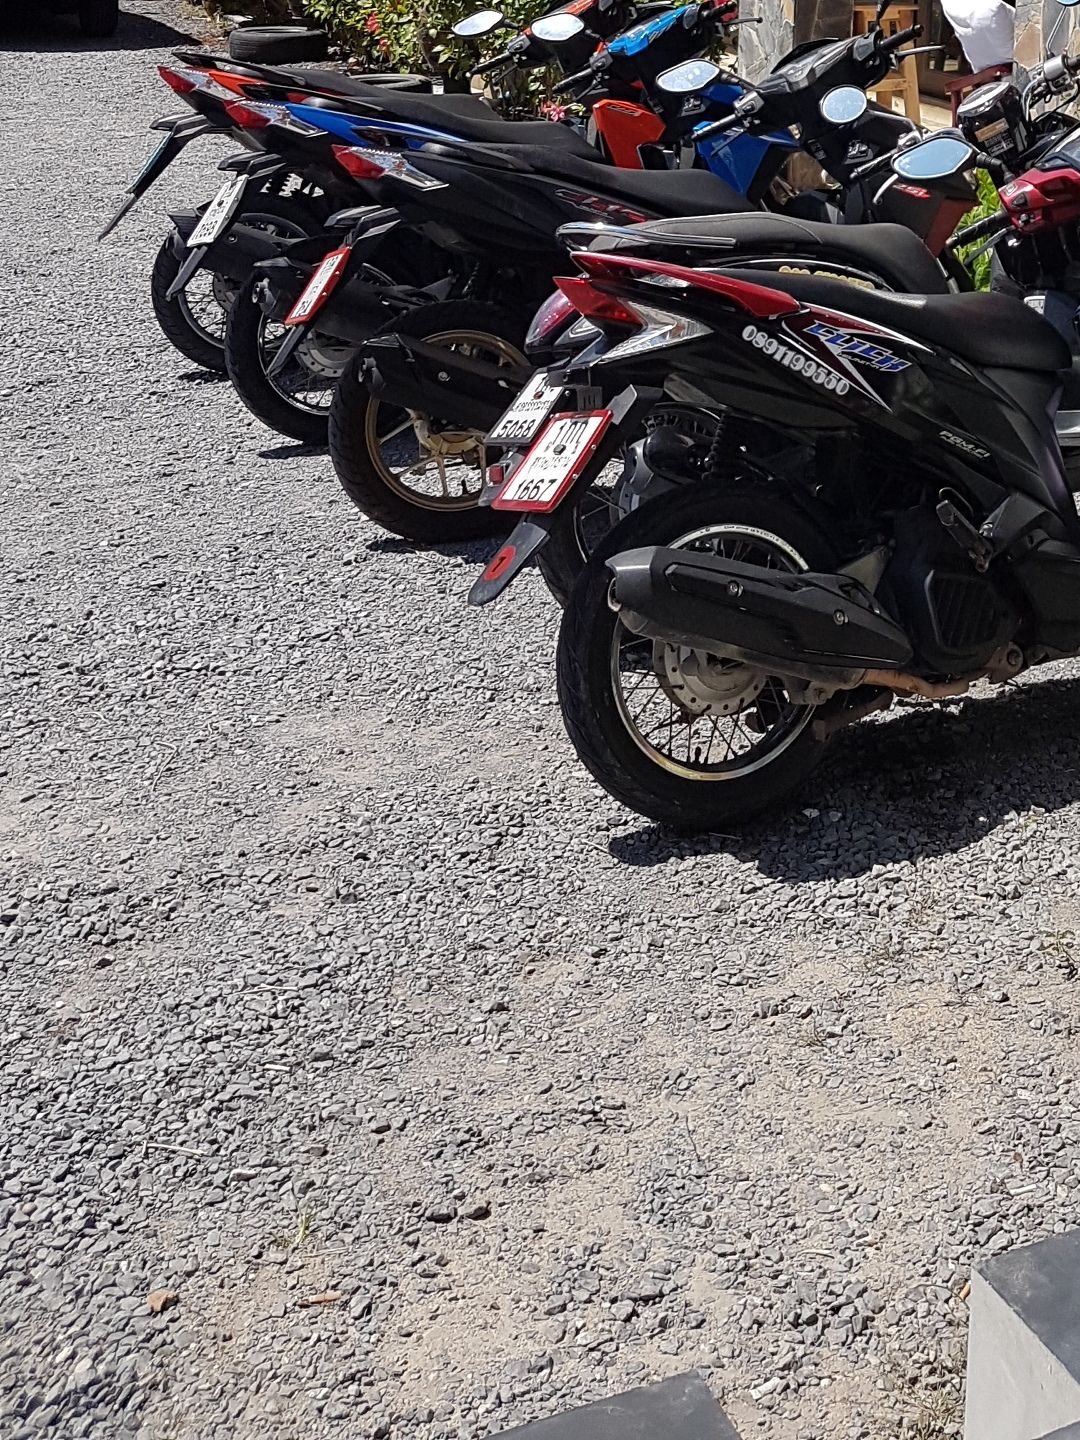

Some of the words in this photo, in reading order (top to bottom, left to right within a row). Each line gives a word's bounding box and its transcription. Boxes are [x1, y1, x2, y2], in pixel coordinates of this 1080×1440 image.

[741, 325, 850, 396] 0891199550
[497, 419, 537, 438] 5068
[511, 478, 558, 501] 1667
